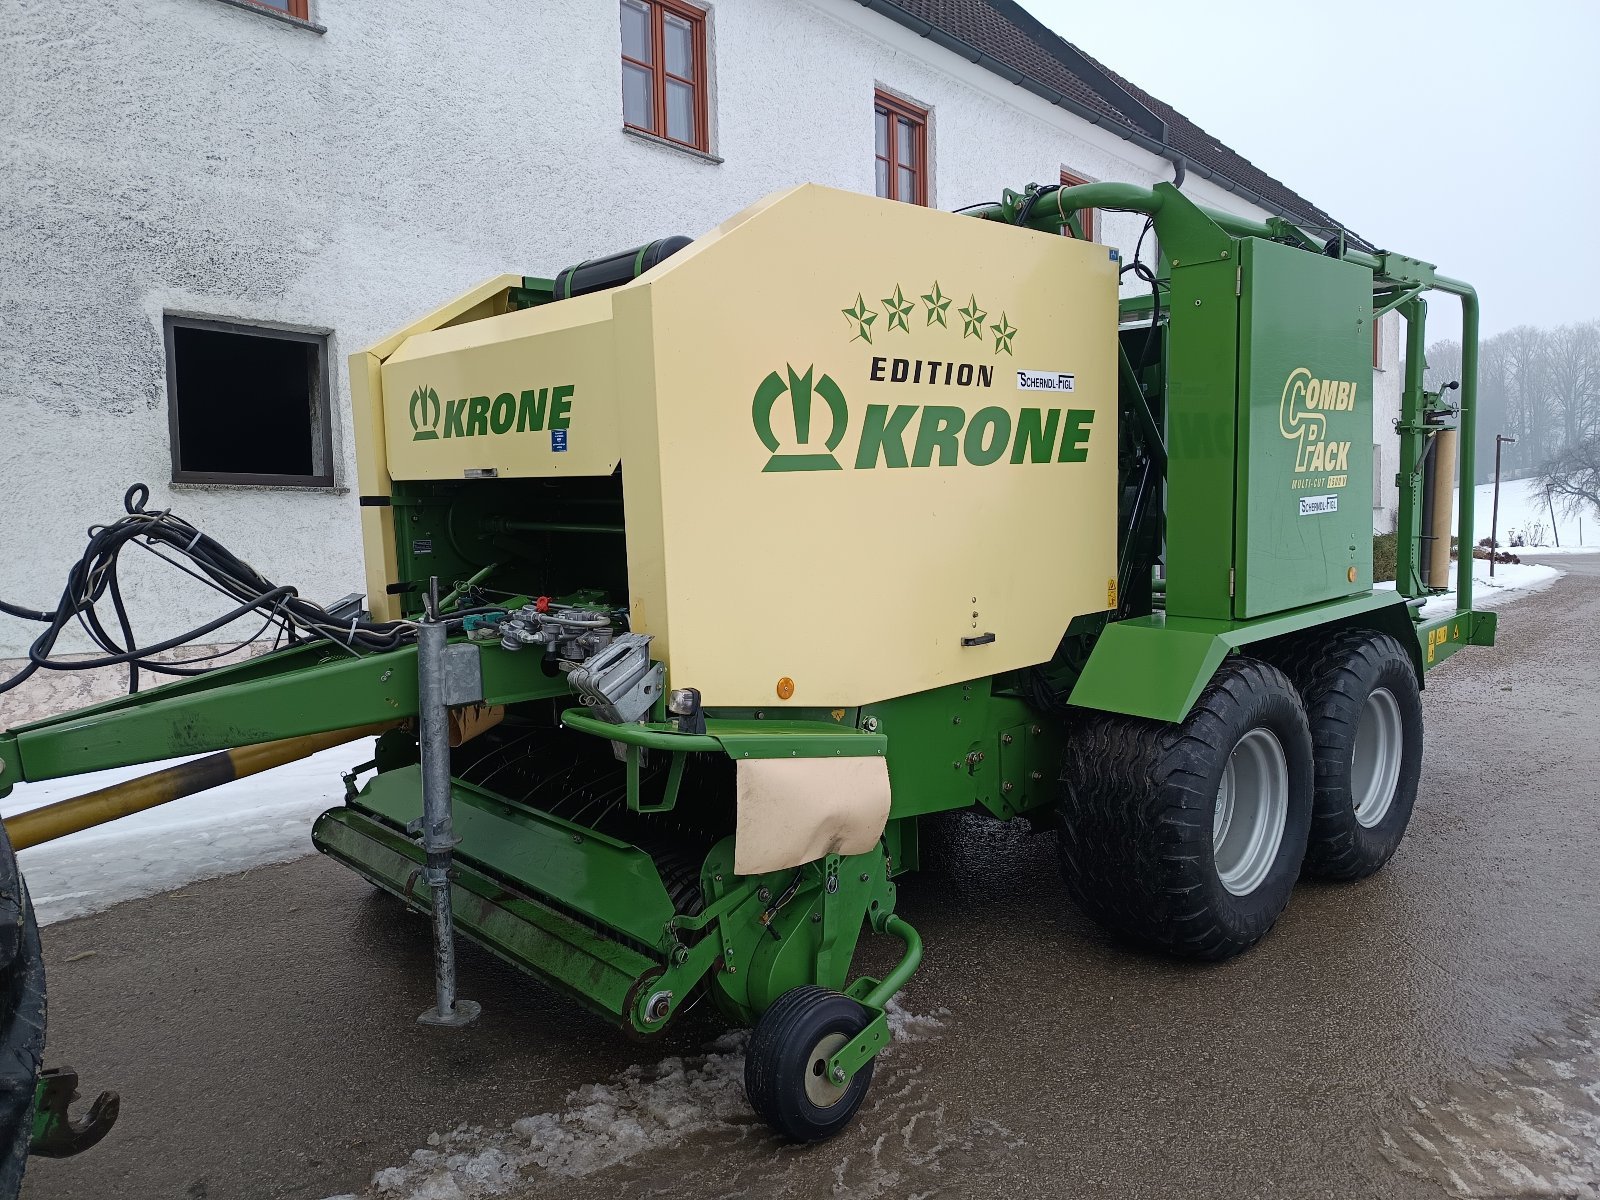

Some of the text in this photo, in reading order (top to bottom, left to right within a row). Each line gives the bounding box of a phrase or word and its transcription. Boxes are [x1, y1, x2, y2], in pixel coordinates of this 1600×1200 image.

[870, 357, 994, 387] EDITION
[443, 385, 575, 439] KRONE
[1279, 367, 1357, 439] COMBI
[854, 404, 1095, 469] KRONE
[1295, 412, 1351, 472] PACK
